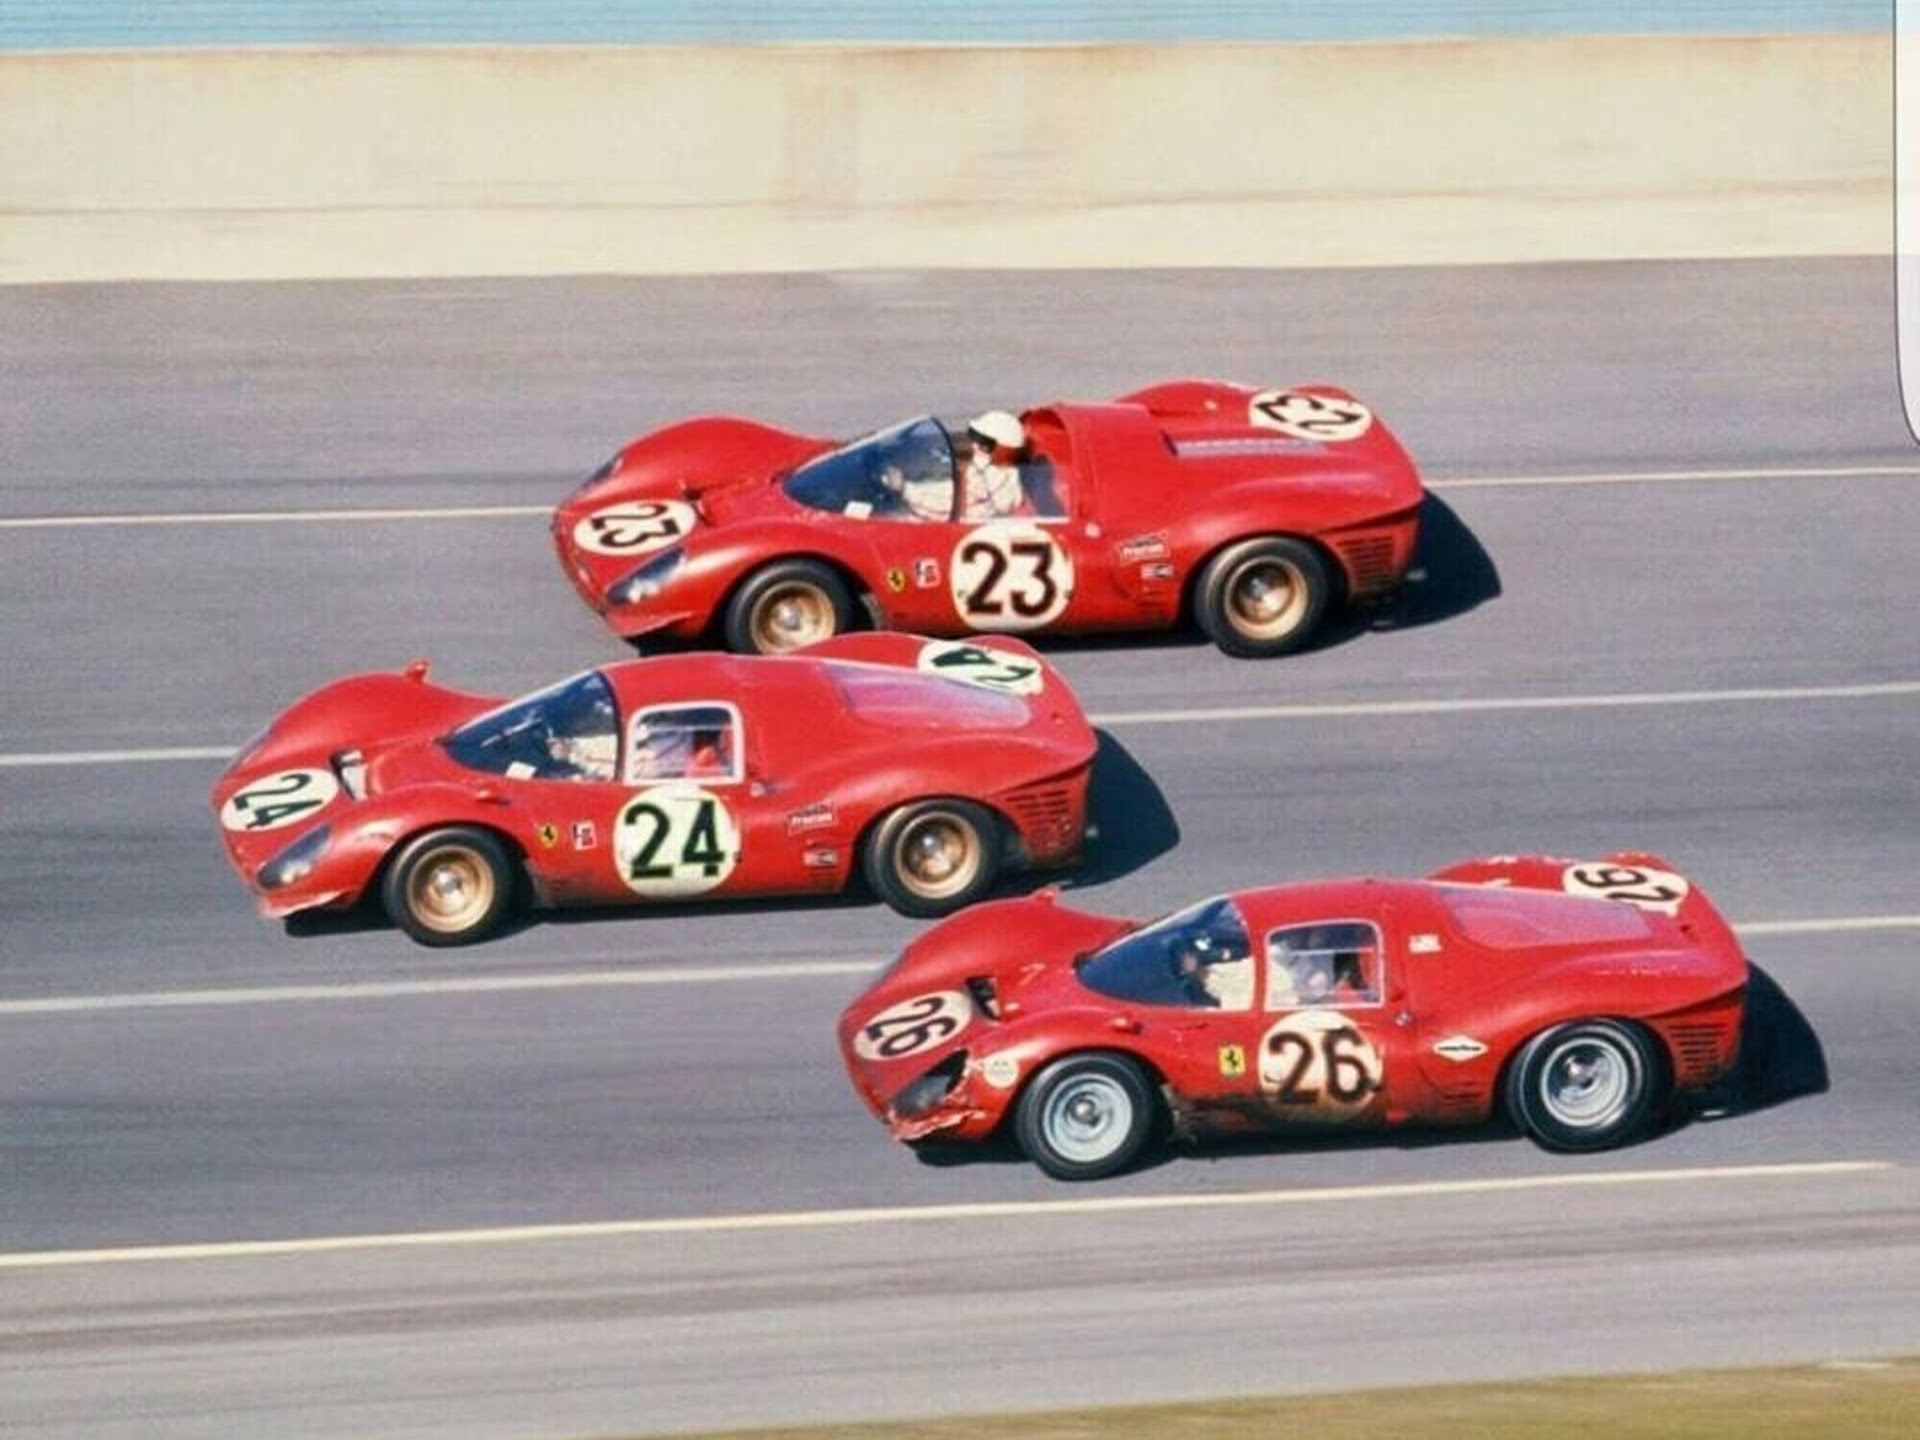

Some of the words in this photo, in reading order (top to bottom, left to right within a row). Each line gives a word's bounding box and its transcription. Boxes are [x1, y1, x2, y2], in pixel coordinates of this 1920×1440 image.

[1254, 394, 1363, 434] 23
[591, 503, 680, 548] 23
[962, 541, 1057, 617] 23
[233, 773, 323, 829] 24
[624, 800, 725, 879] 24
[866, 997, 957, 1056] 26
[1268, 1026, 1377, 1102] 26
